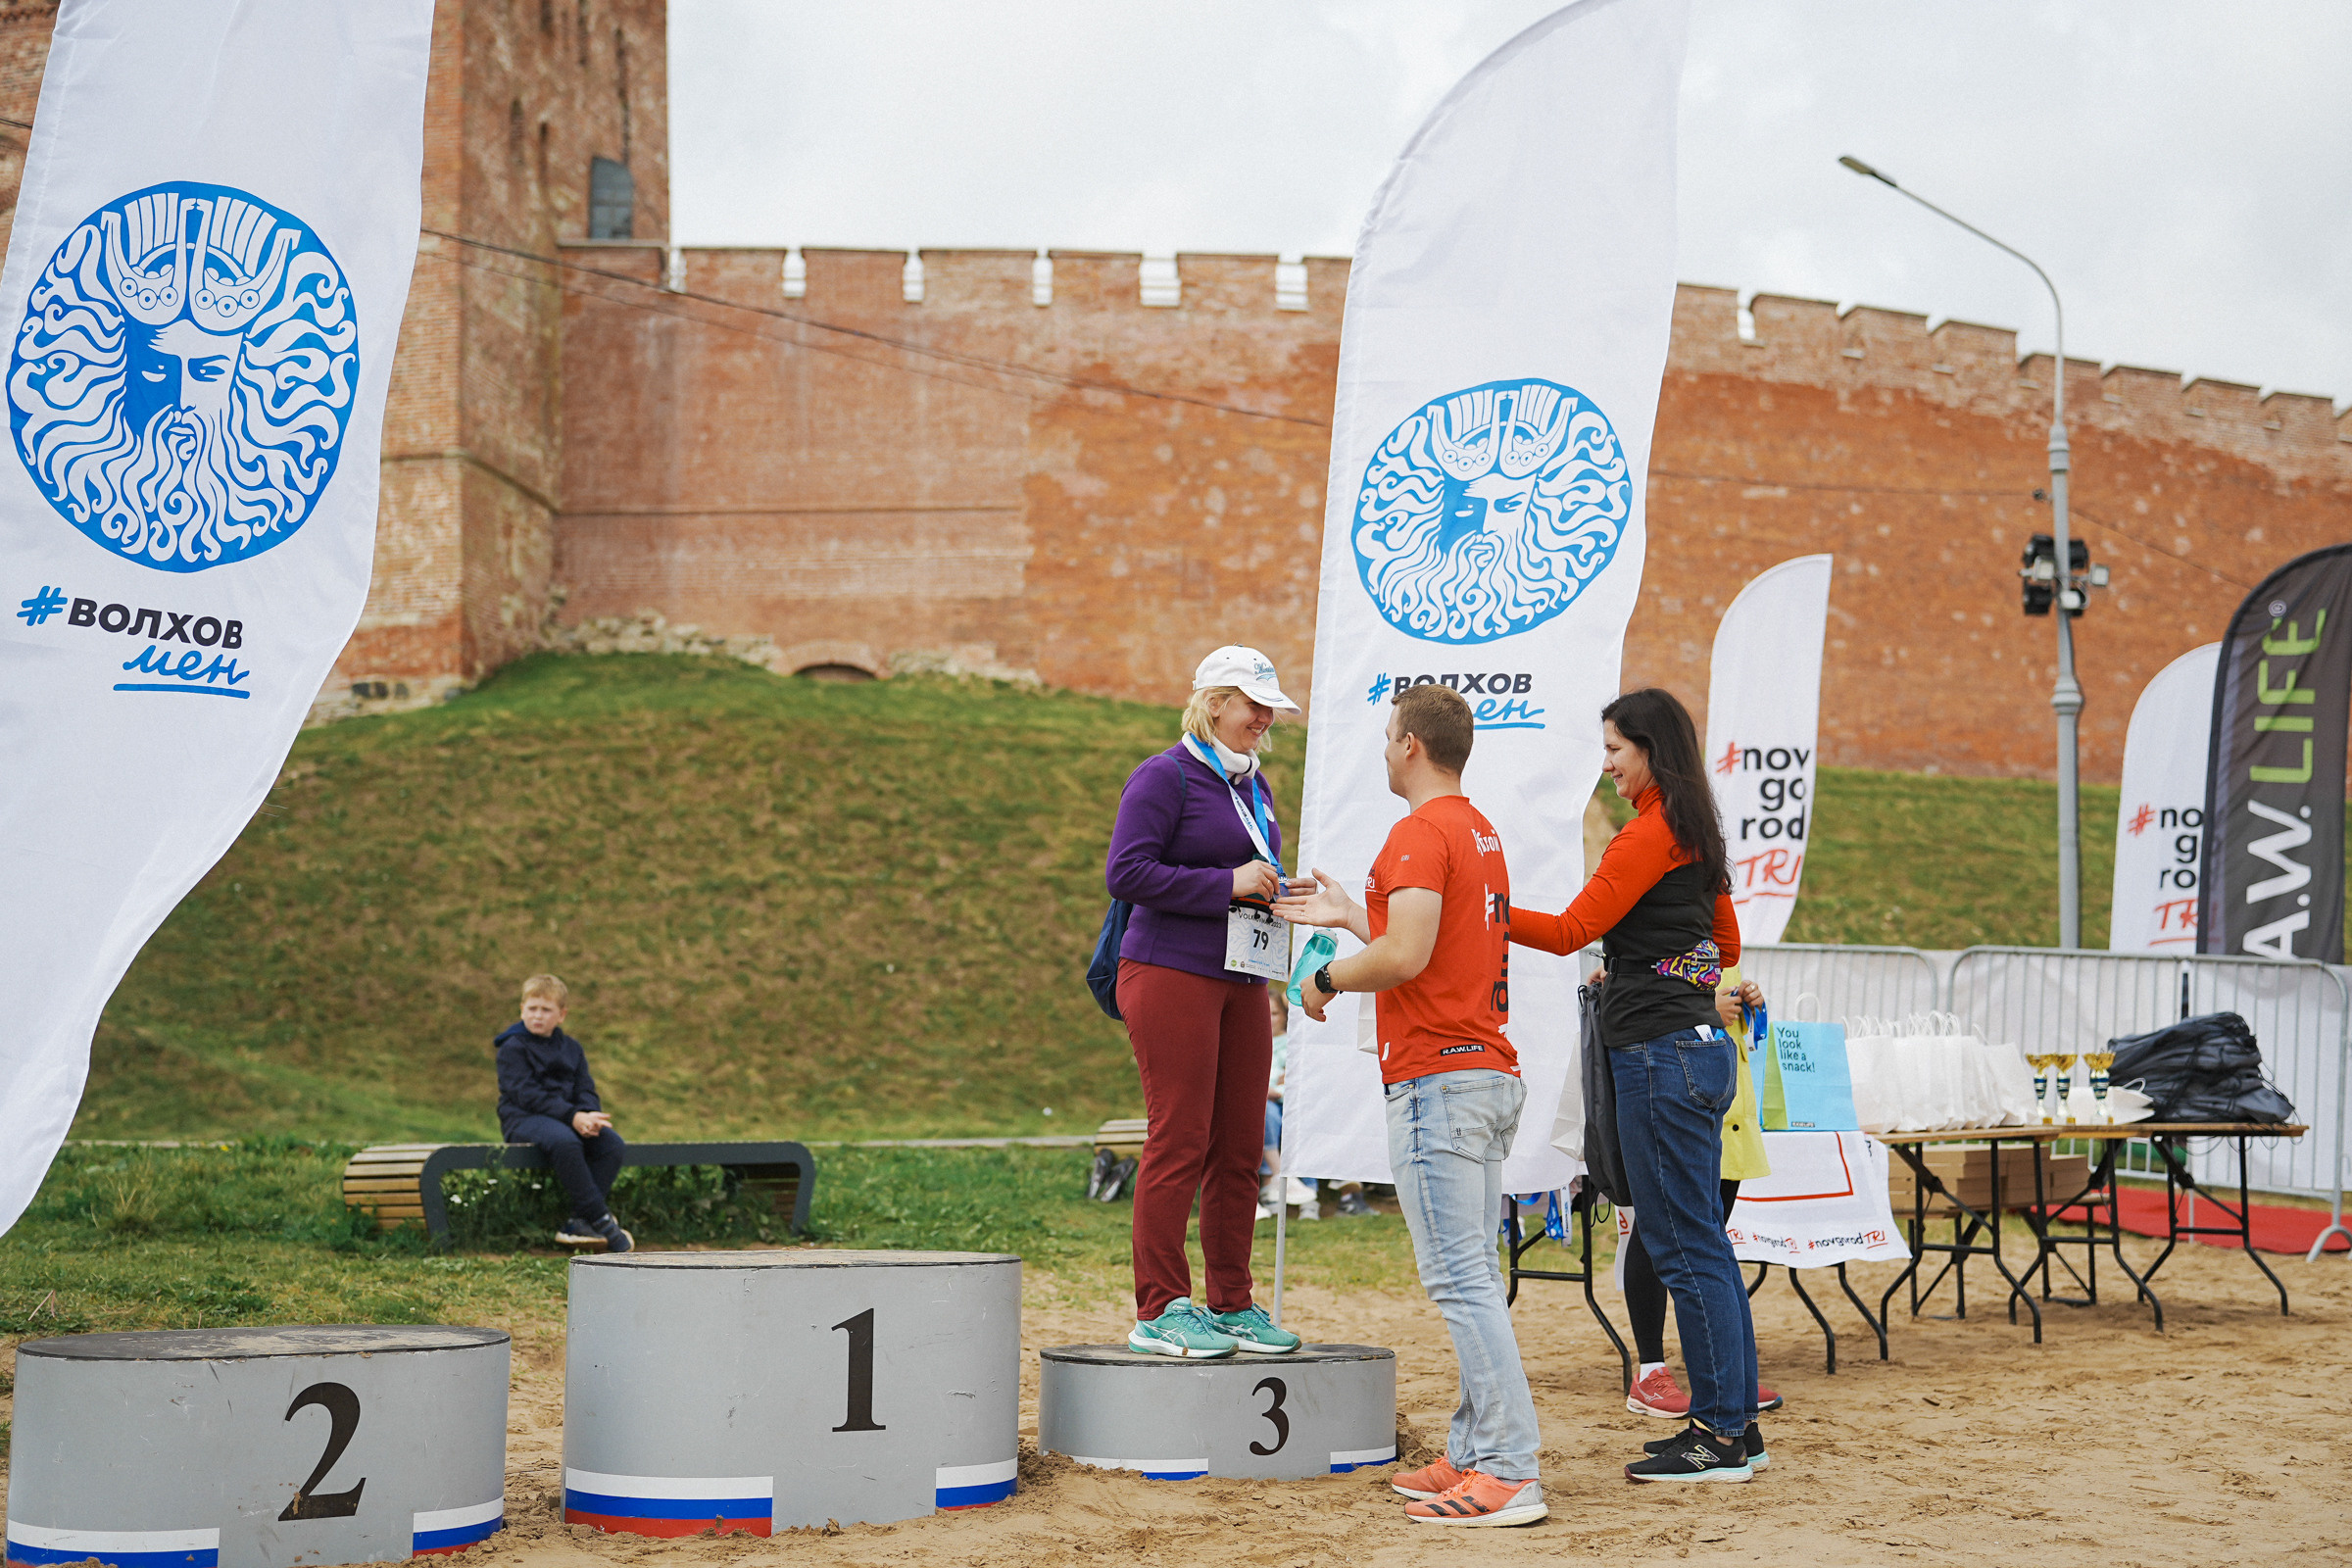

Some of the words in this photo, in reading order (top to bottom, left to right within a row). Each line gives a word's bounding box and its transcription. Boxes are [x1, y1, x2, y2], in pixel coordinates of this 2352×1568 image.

[122, 644, 250, 685] мен
[1467, 698, 1545, 721] ен
[1716, 742, 1810, 774] #nov
[1741, 806, 1805, 841] rod
[2128, 804, 2205, 836] #no
[1737, 849, 1802, 888] TRI
[2159, 869, 2197, 890] ro
[1253, 929, 1269, 951] 79
[1777, 1027, 1799, 1038] You
[1778, 1039, 1801, 1050] look
[1780, 1050, 1799, 1060] like
[1800, 1053, 1807, 1061] a
[1782, 1062, 1816, 1073] snack!
[831, 1307, 887, 1432] 1
[1250, 1377, 1291, 1456] 3
[277, 1382, 368, 1522] 2
